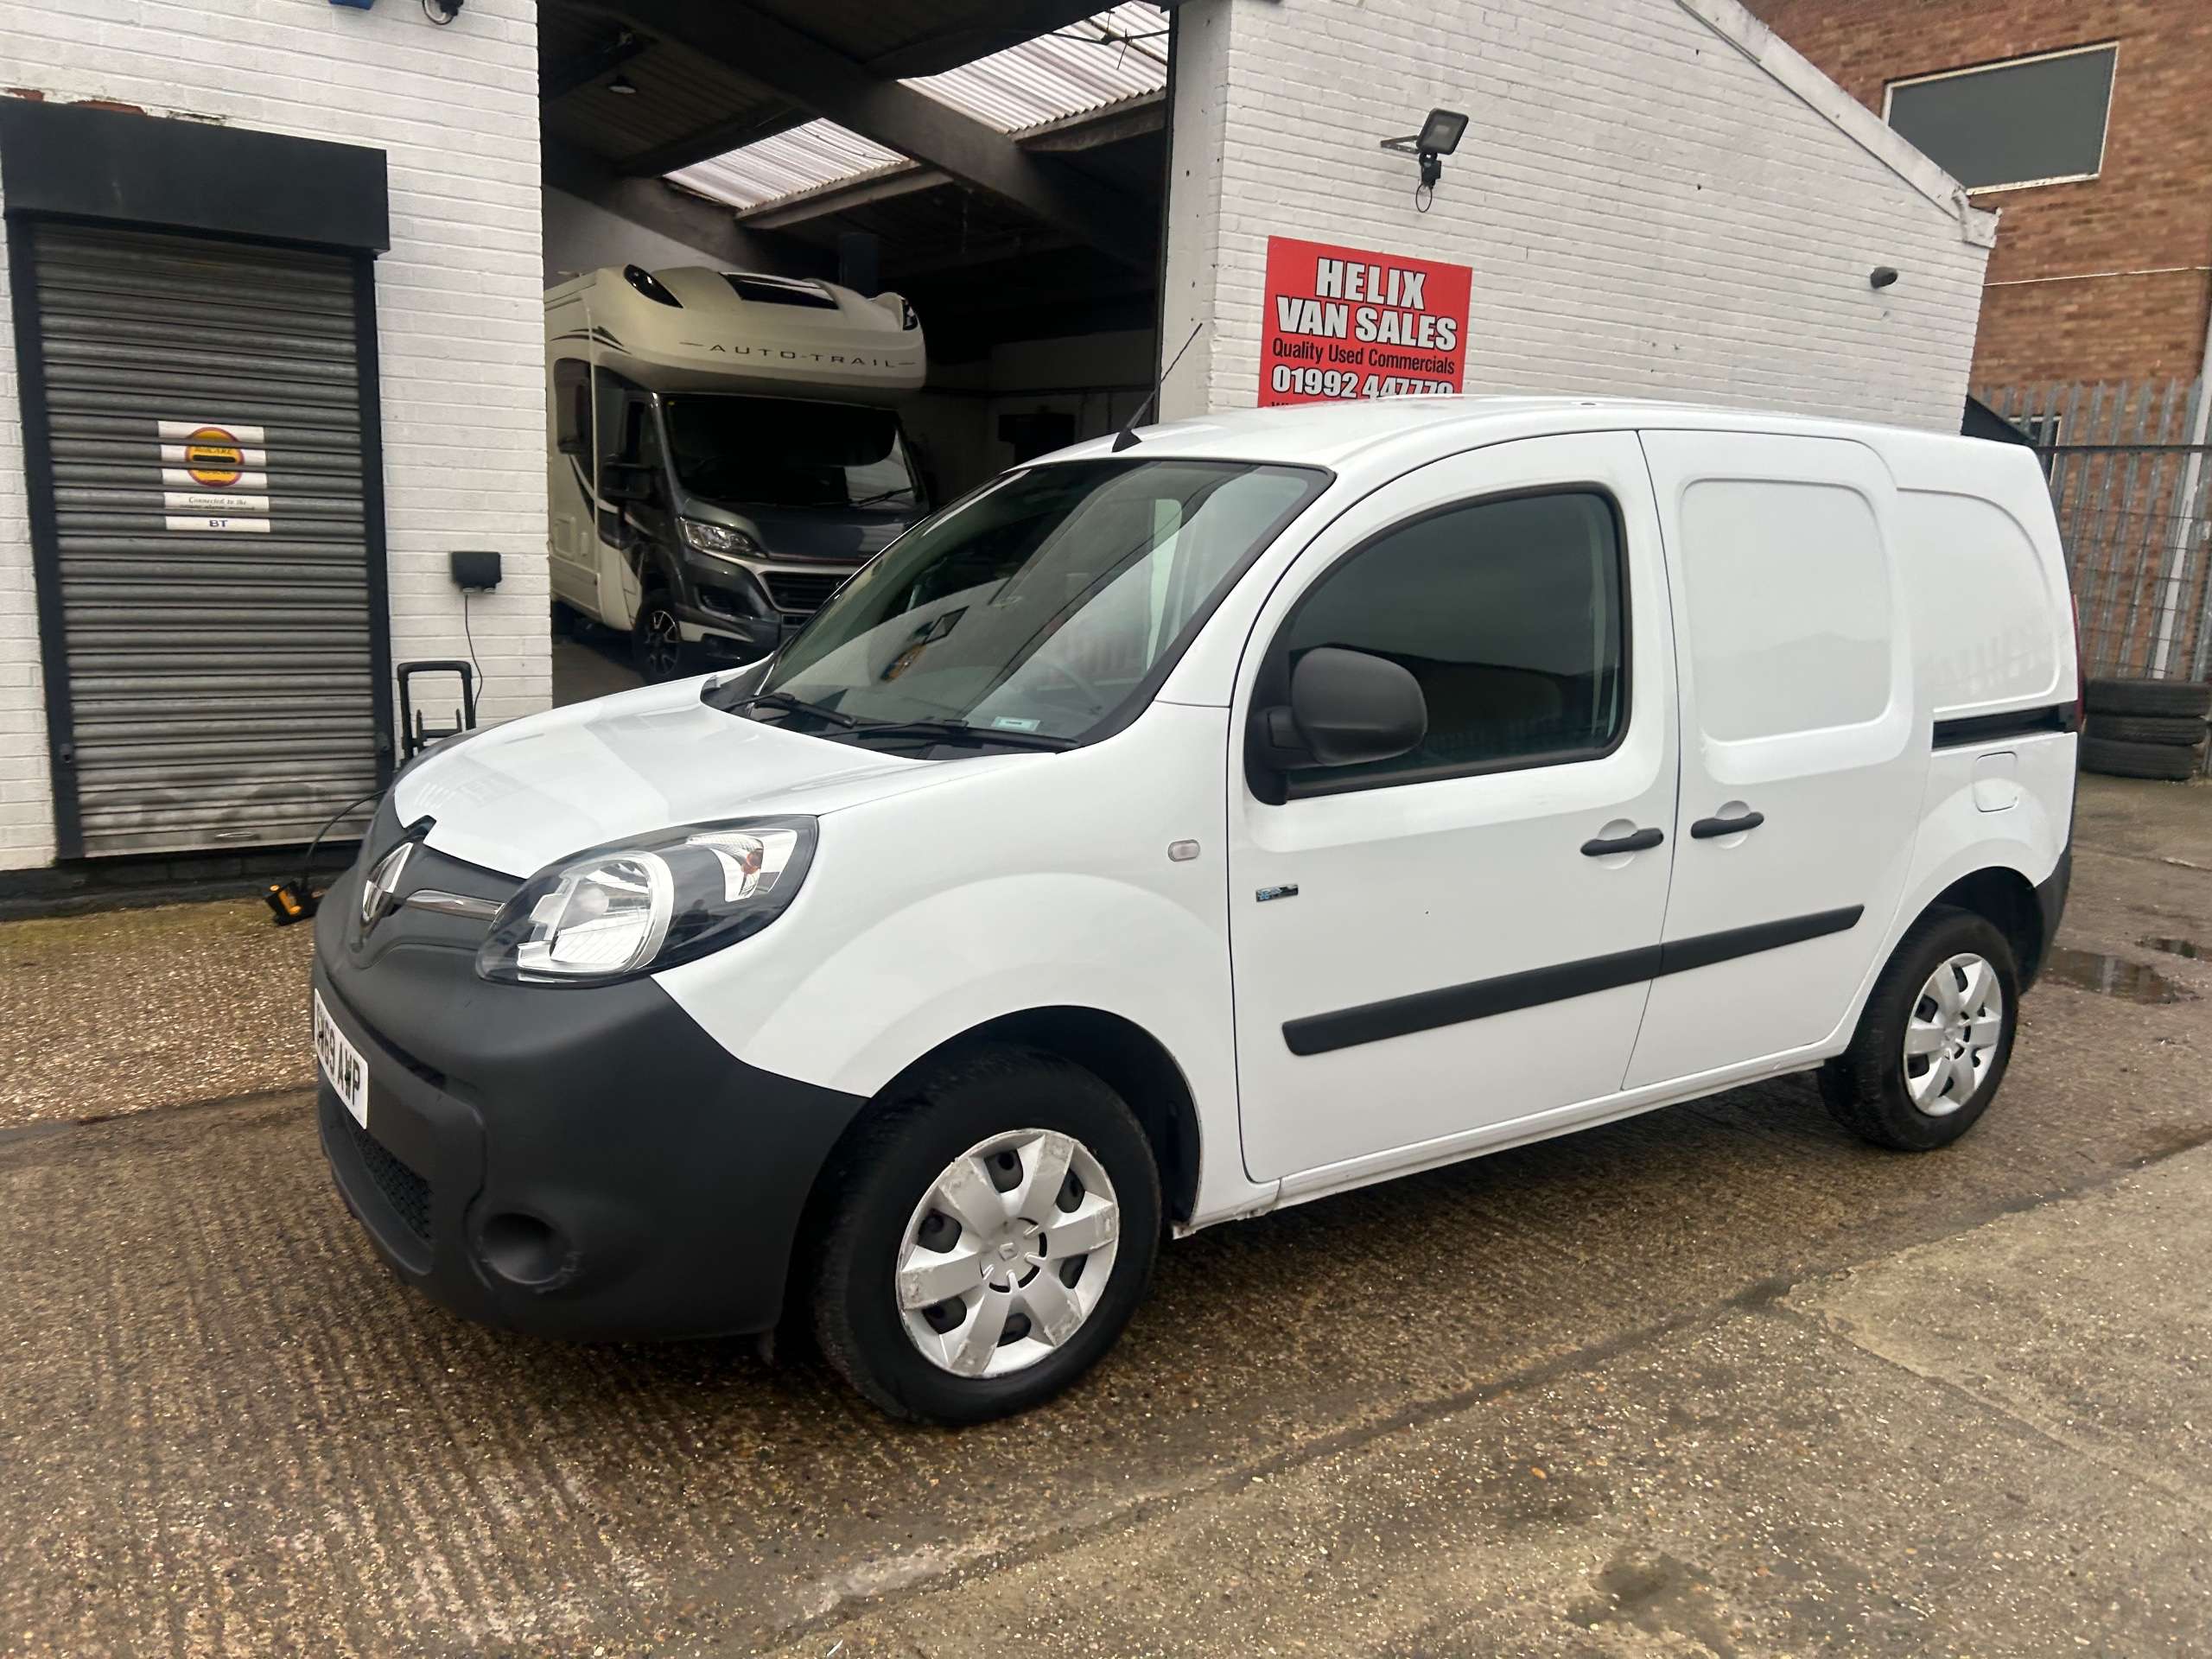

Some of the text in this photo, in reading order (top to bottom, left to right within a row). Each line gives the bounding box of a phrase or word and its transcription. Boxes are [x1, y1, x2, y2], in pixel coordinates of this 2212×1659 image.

[1315, 257, 1427, 311] HELIX
[1275, 295, 1458, 352] VAN SALES
[710, 344, 895, 368] AUTO-TRAIL
[1272, 337, 1455, 374] Quality Used Commercials
[1271, 364, 1359, 399] 01992
